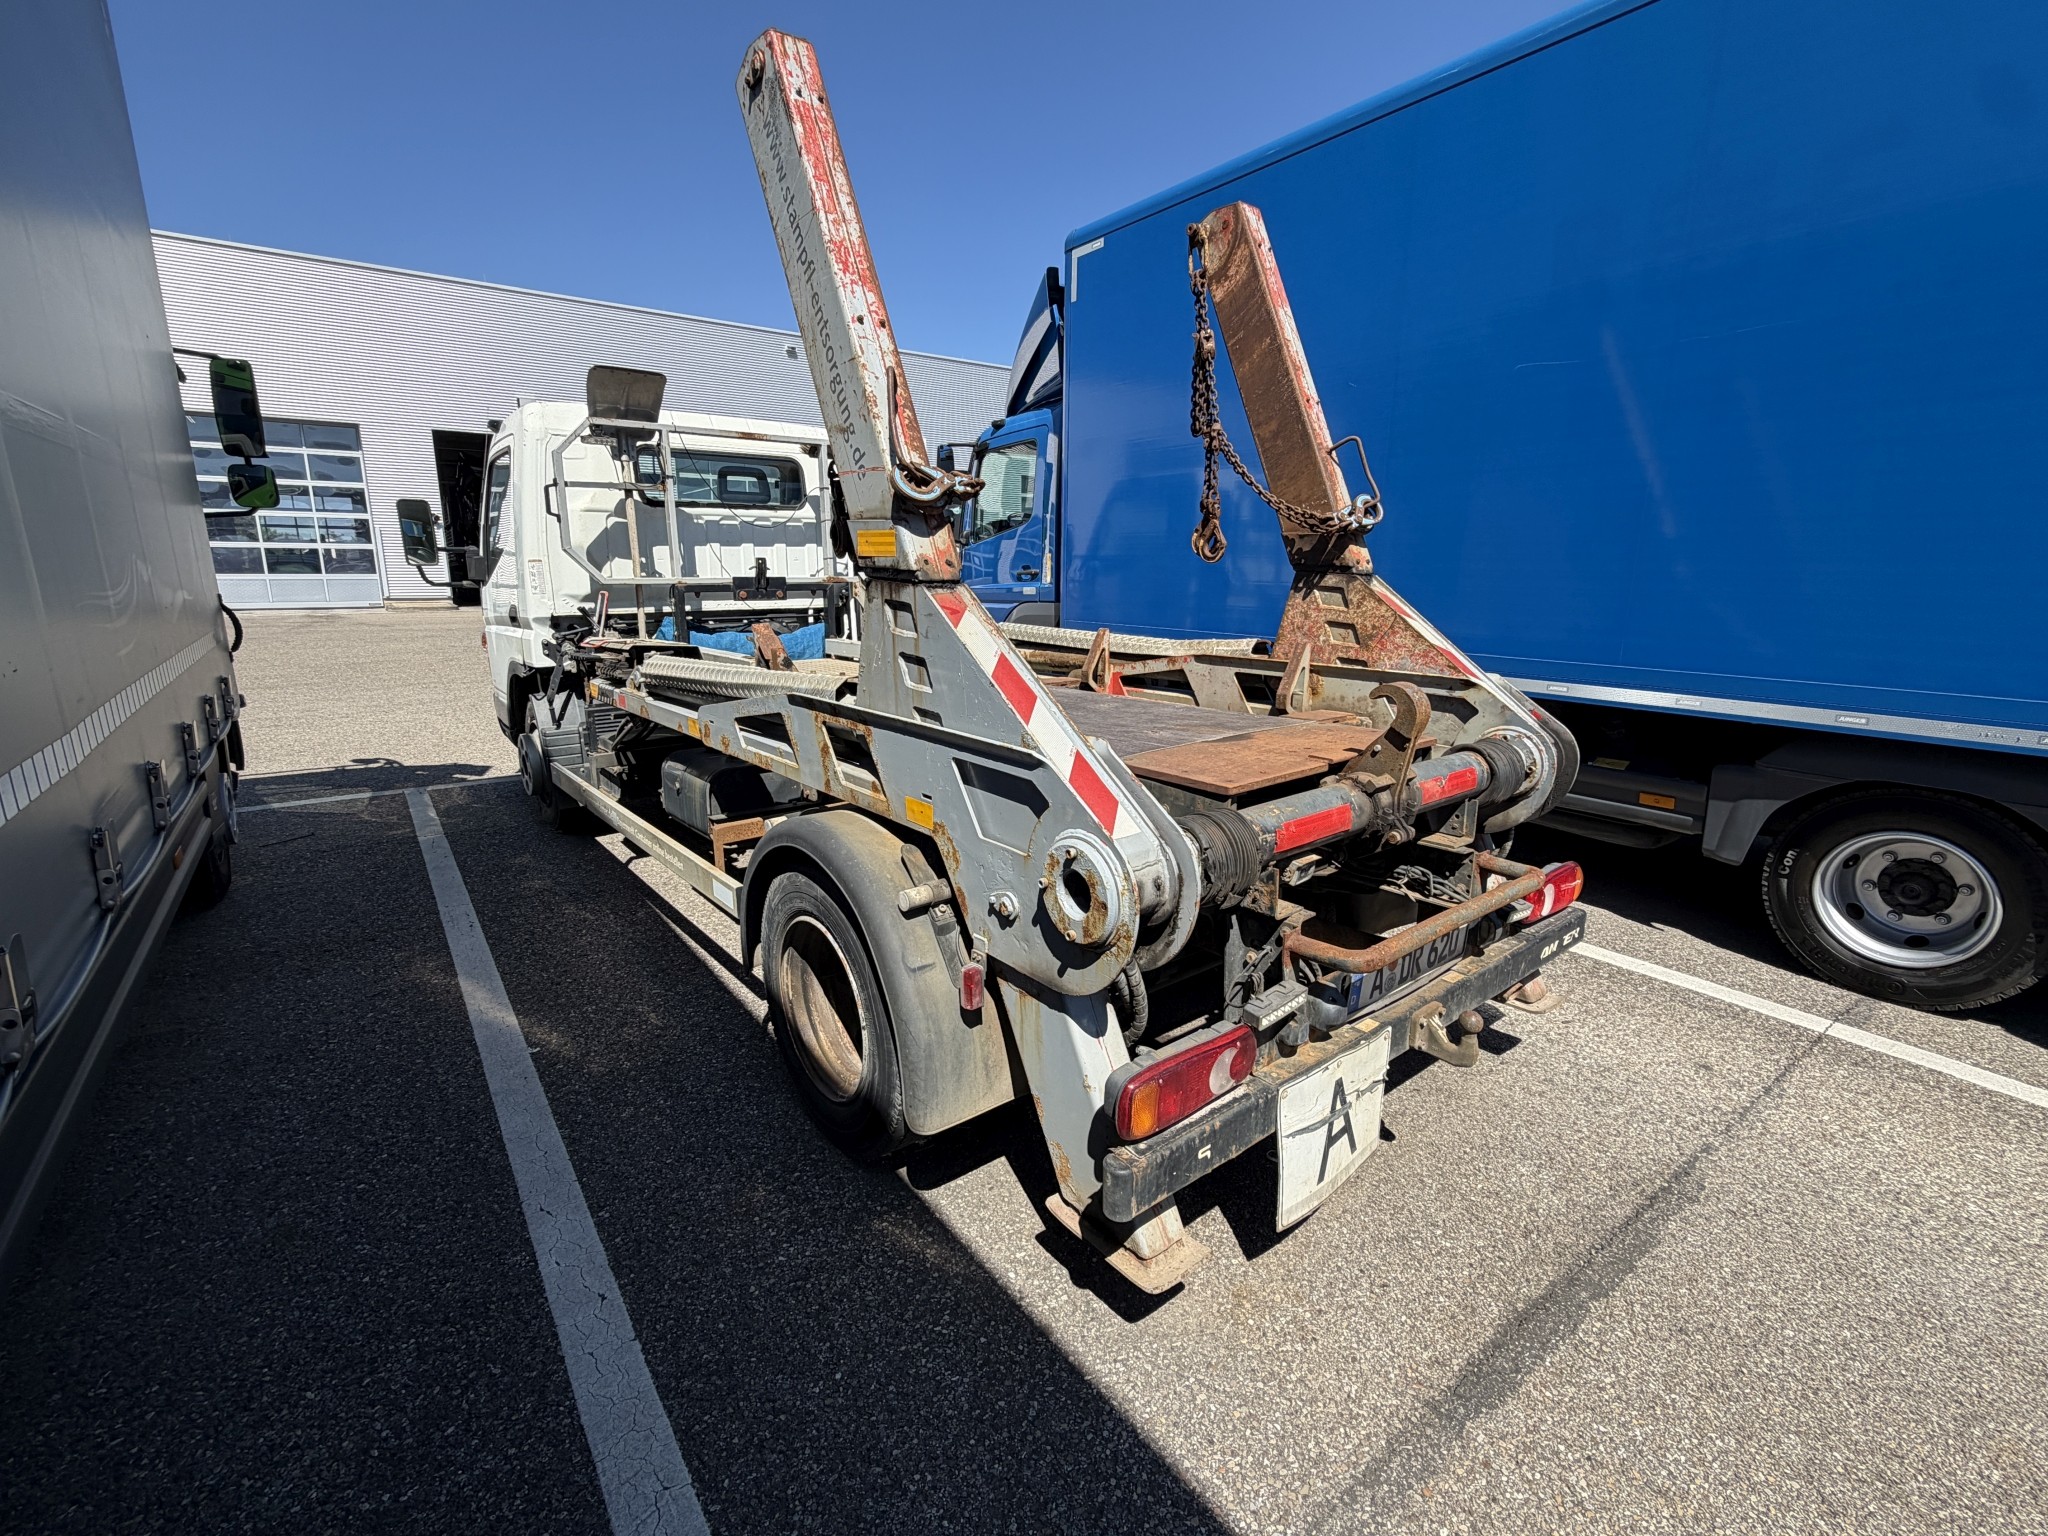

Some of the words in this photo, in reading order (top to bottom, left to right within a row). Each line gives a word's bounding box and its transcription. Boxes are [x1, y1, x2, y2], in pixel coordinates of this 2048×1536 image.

[763, 111, 866, 481] www.stampfl-entsorgung.de
[1369, 969, 1384, 999] A
[1427, 929, 1460, 969] 620
[1317, 1076, 1358, 1186] A
